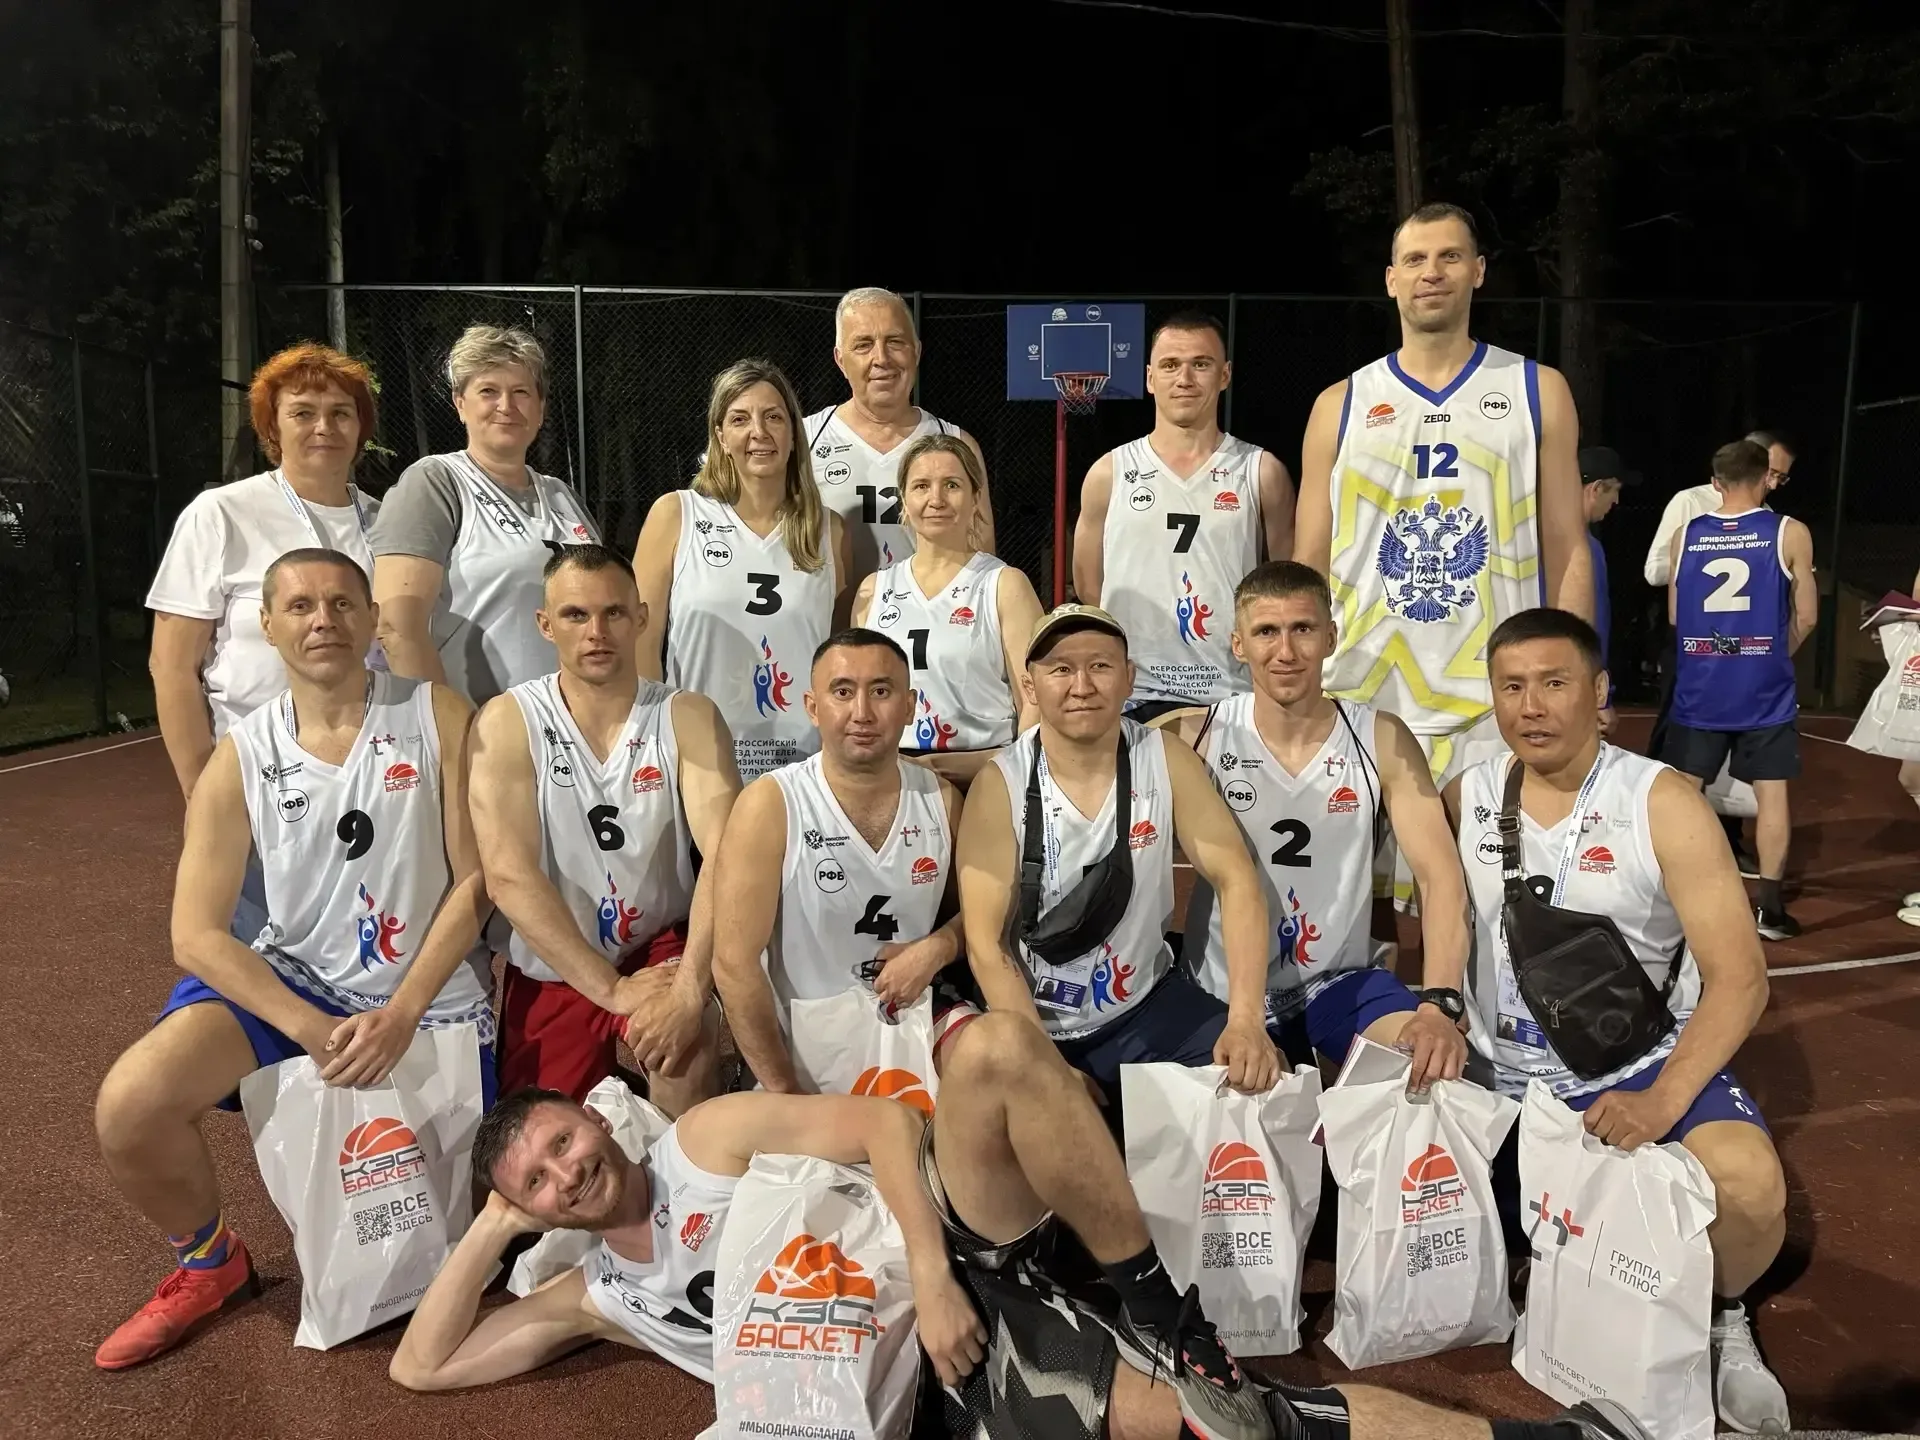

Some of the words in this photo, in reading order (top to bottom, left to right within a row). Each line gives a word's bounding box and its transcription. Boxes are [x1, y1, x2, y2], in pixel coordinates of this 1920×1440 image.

[1484, 401, 1508, 410] РФБ
[1412, 442, 1459, 479] 12
[828, 468, 848, 478] РФБ
[856, 485, 903, 524] 12
[1132, 494, 1152, 503] РФБ
[1167, 512, 1201, 553] 7
[1700, 533, 1758, 543] ПРИВОЛЖСКИЙ
[706, 549, 729, 559] РФБ
[1688, 542, 1744, 552] ФЕДЕРАЛЬНЫЙ
[1745, 540, 1771, 549] ОКРУГ
[1702, 557, 1750, 612] 2
[745, 572, 782, 616] 3
[907, 628, 930, 670] 1
[1683, 640, 1712, 652] 2026
[1150, 664, 1219, 672] ВСЕРОССИЙСКИ
[1179, 671, 1222, 680] УЧИТЕЛЕЙ
[733, 738, 797, 747] ЕРОССИЙСКИЙ
[735, 749, 750, 757] ЕЗД
[752, 747, 797, 756] УЧИТЕЛЕЙ
[736, 757, 788, 766] ИЗИЧЕСКОЙ
[553, 765, 571, 775] РФ
[1228, 790, 1253, 801] РФБ
[281, 796, 305, 812] ФБ
[337, 809, 374, 861] 9
[587, 804, 625, 851] 6
[1270, 818, 1311, 868] 2
[819, 870, 845, 881] РФБ
[854, 894, 899, 941] 4
[343, 1161, 421, 1195] БАСКЕТ
[390, 1191, 429, 1217] ВСЕ
[1202, 1197, 1269, 1214] БАСКЕТ
[394, 1207, 431, 1222] ПОДРОБНОСТИ
[395, 1214, 433, 1232] ЗДЕСЬ
[1236, 1231, 1272, 1249] ВСЕ
[1432, 1227, 1466, 1250] ВСЕ
[1434, 1244, 1467, 1256] ПОДРОБНОСТИ
[1238, 1255, 1273, 1267] ЗДЕСЬ
[1435, 1251, 1469, 1267] ЗДЕСЬ
[1610, 1250, 1661, 1283] ГРУППА
[1609, 1263, 1618, 1277] Т
[1619, 1269, 1660, 1298] ПЛЮС
[370, 1284, 430, 1312] #МЫОДНАКОМ
[735, 1324, 871, 1354] БАСКЕТ
[1218, 1329, 1276, 1339] ОДНАКОМАНДА
[735, 1350, 771, 1358] ШКОЛЬНАЯ
[773, 1351, 836, 1362] БАСКЕТБОЛЬНАЯ
[839, 1356, 859, 1364] ЛИГА
[1588, 1380, 1607, 1397] УЮТ
[738, 1421, 856, 1440] #МЫОДНАКОМАНДА
